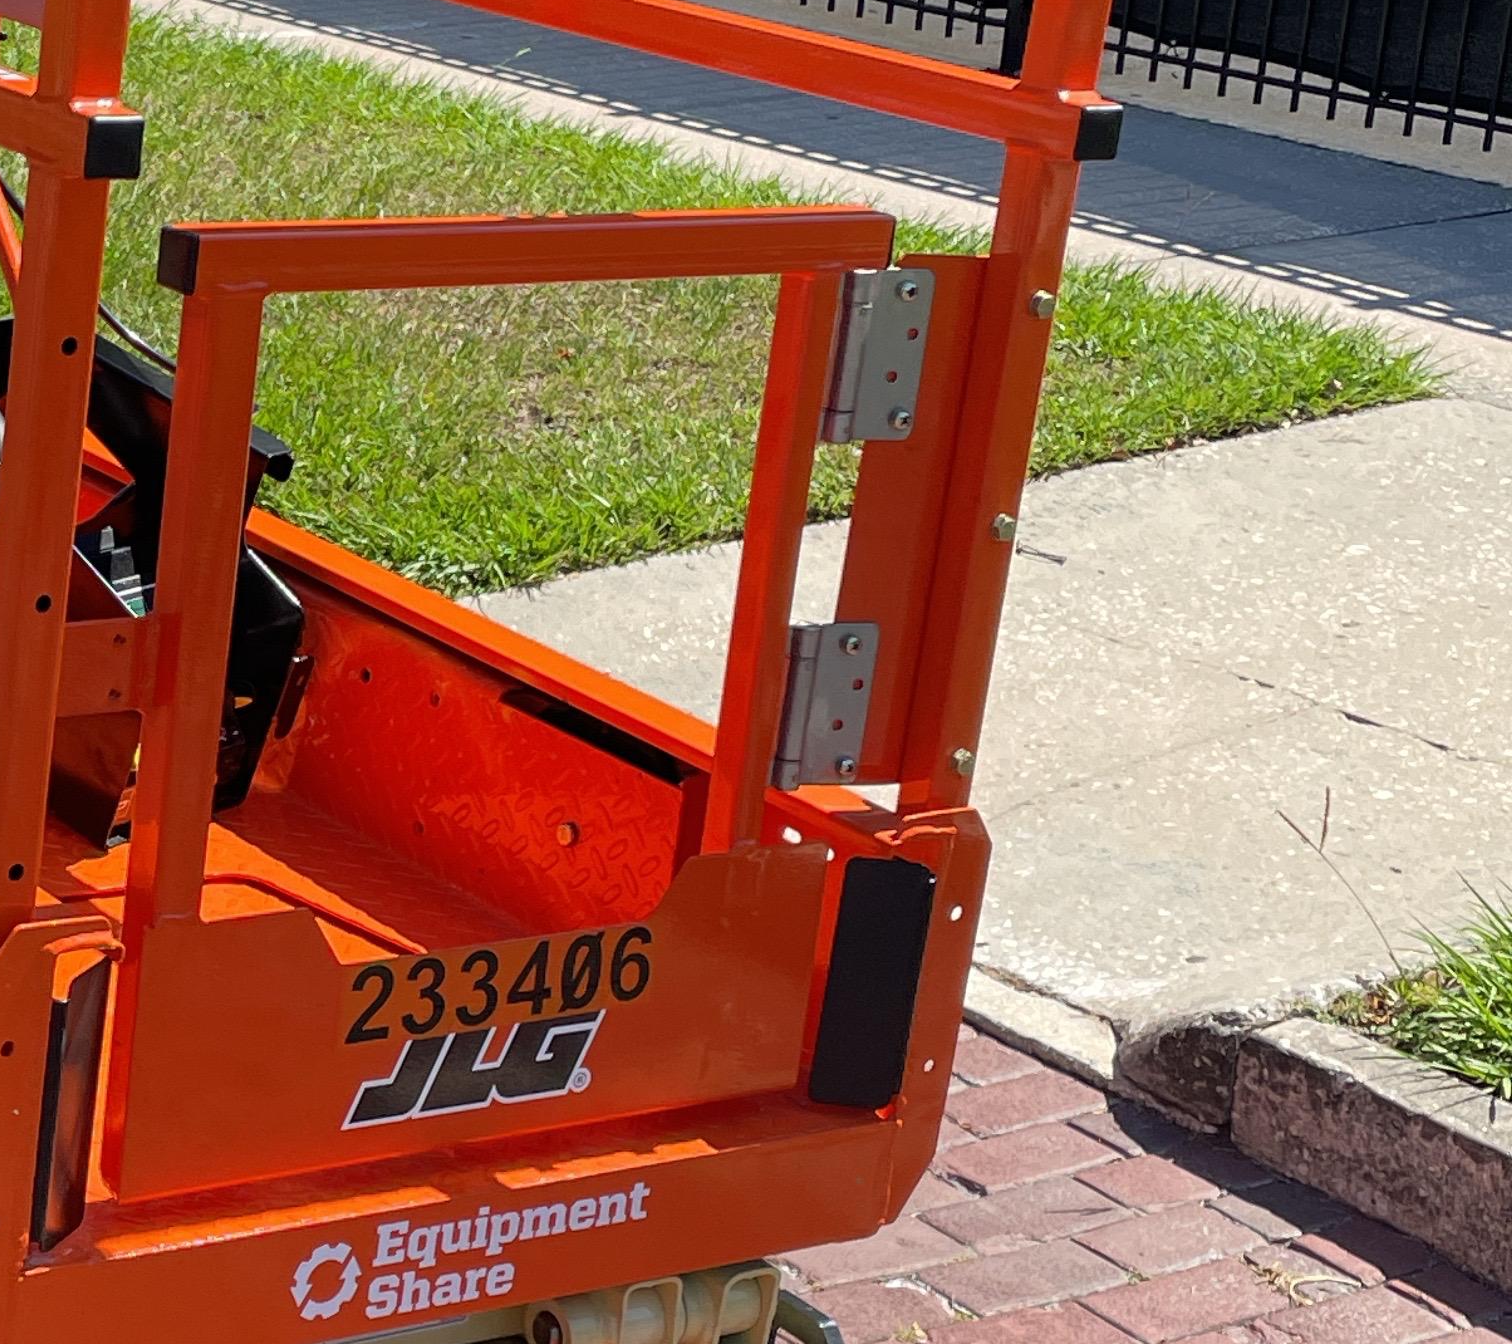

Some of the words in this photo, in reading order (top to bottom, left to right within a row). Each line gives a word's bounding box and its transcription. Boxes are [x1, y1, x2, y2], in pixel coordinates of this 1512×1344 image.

[345, 926, 652, 1045] 233406
[372, 1182, 651, 1268] Equipment
[365, 1261, 515, 1320] Share
